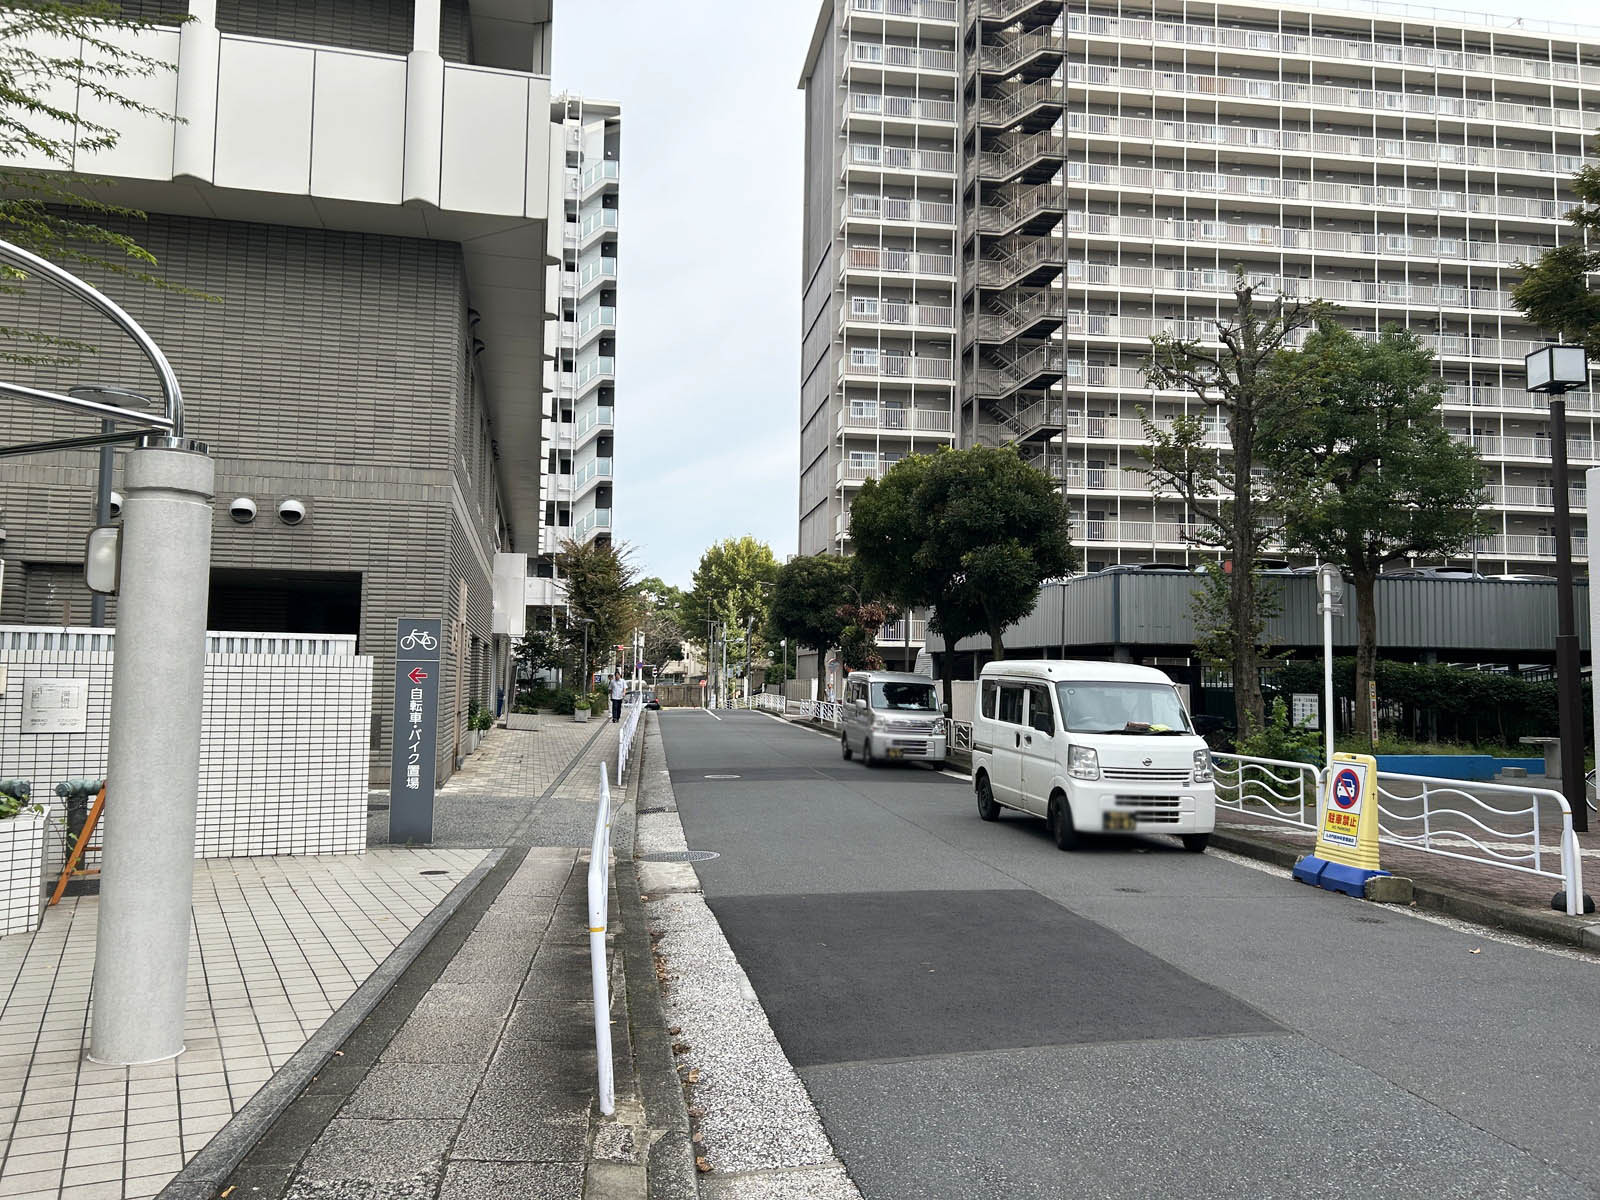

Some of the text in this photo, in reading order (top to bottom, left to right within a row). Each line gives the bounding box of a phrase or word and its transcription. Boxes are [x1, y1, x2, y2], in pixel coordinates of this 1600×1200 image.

[406, 688, 423, 790] 自転車・バイク置場
[1328, 813, 1357, 827] 駐車禁止
